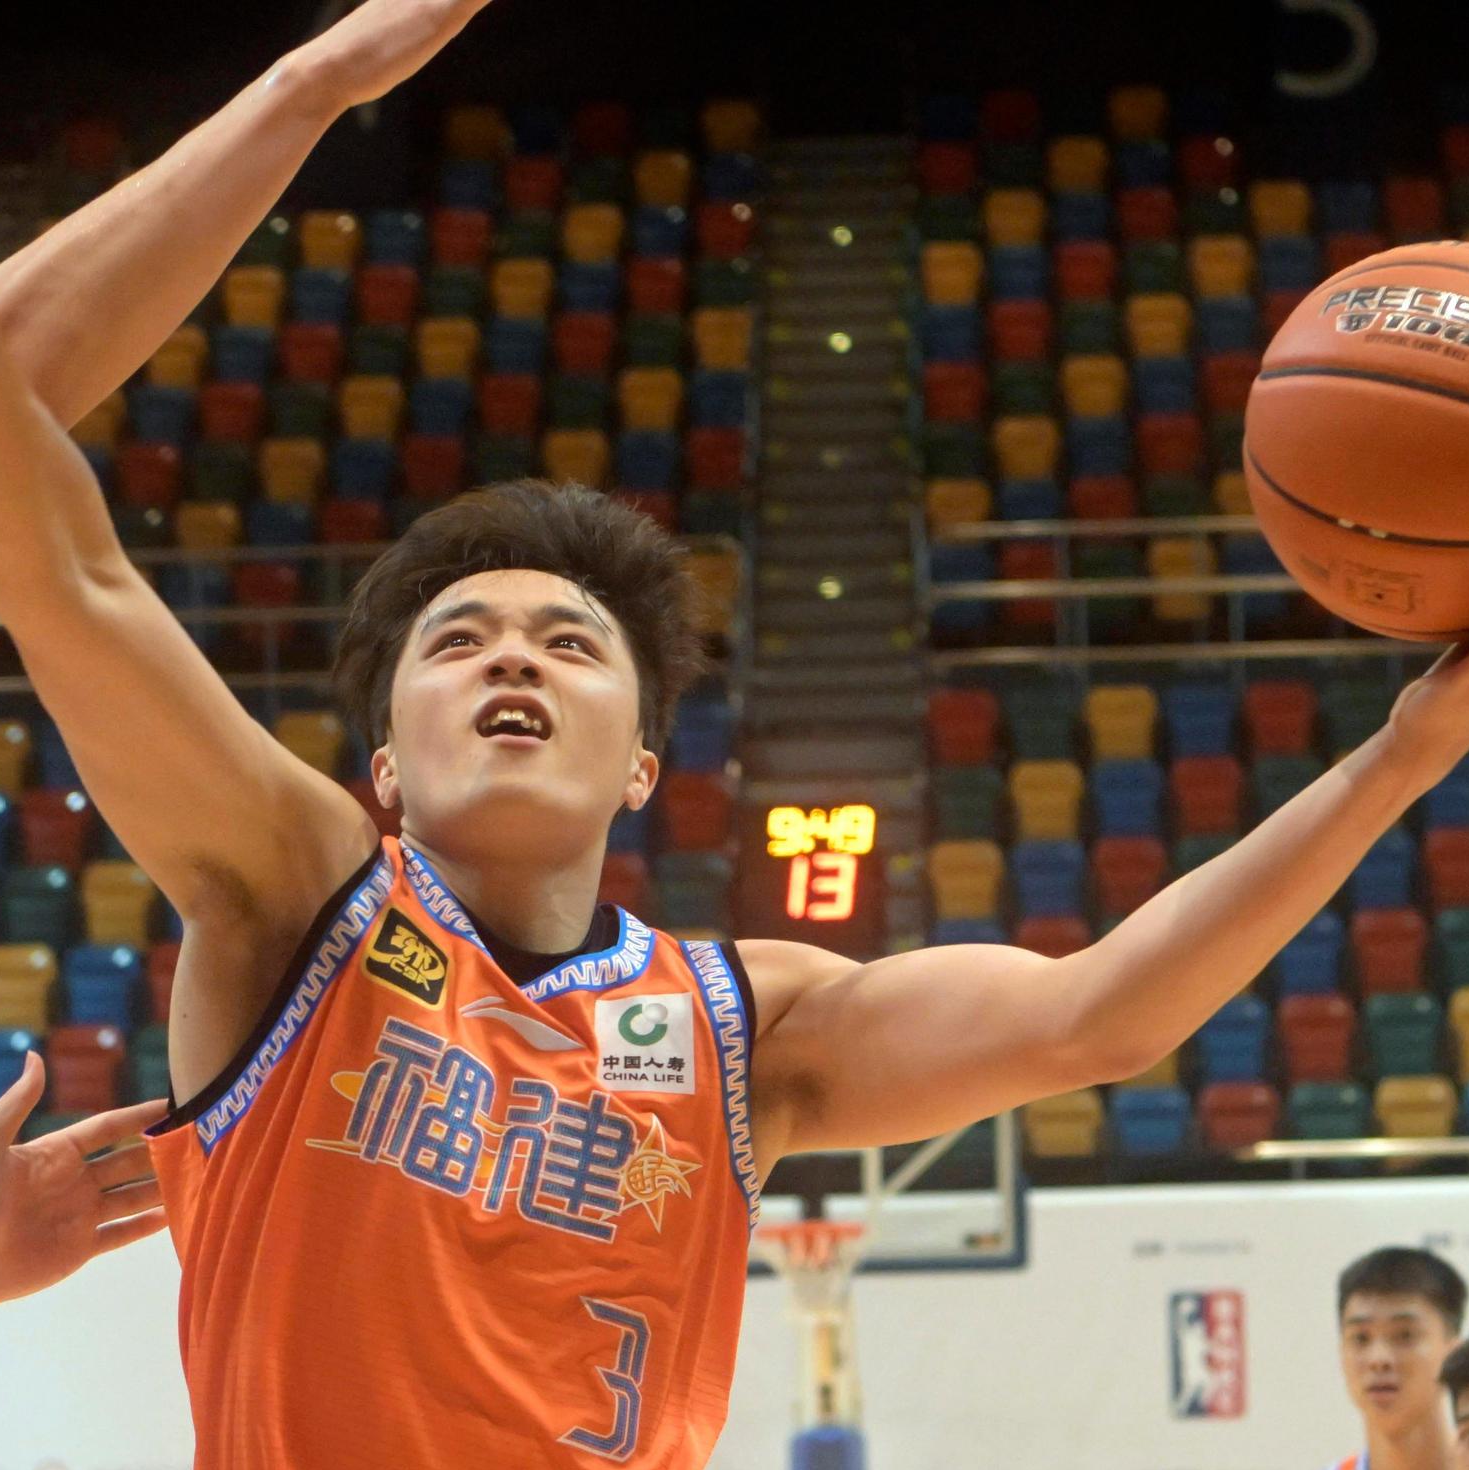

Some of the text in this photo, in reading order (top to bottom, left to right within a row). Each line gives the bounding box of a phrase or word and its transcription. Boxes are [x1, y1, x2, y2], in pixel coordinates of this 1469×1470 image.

[786, 853, 857, 921] 13
[602, 1055, 686, 1072] 中国人寿
[602, 1072, 685, 1083] CHINA LIFE
[557, 1295, 652, 1462] 3
